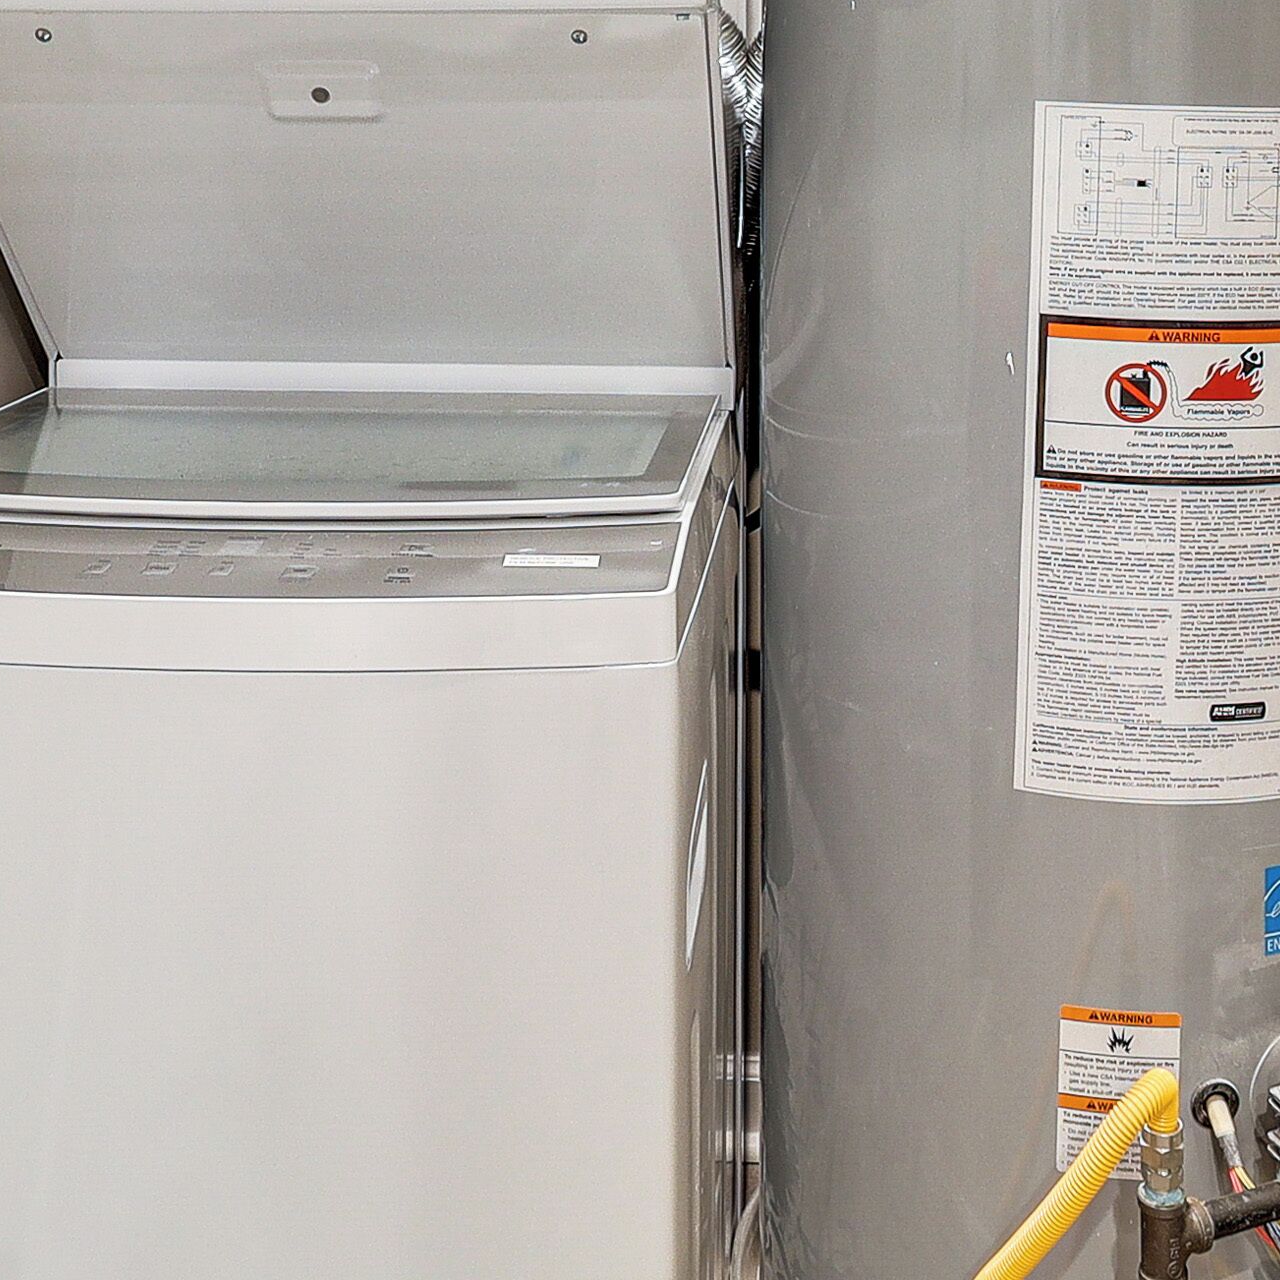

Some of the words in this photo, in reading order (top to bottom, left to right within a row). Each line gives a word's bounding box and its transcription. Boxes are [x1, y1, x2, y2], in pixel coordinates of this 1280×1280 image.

[1162, 332, 1220, 342] WARNING
[1227, 408, 1250, 416] Vapors
[1100, 1012, 1153, 1024] WARNING
